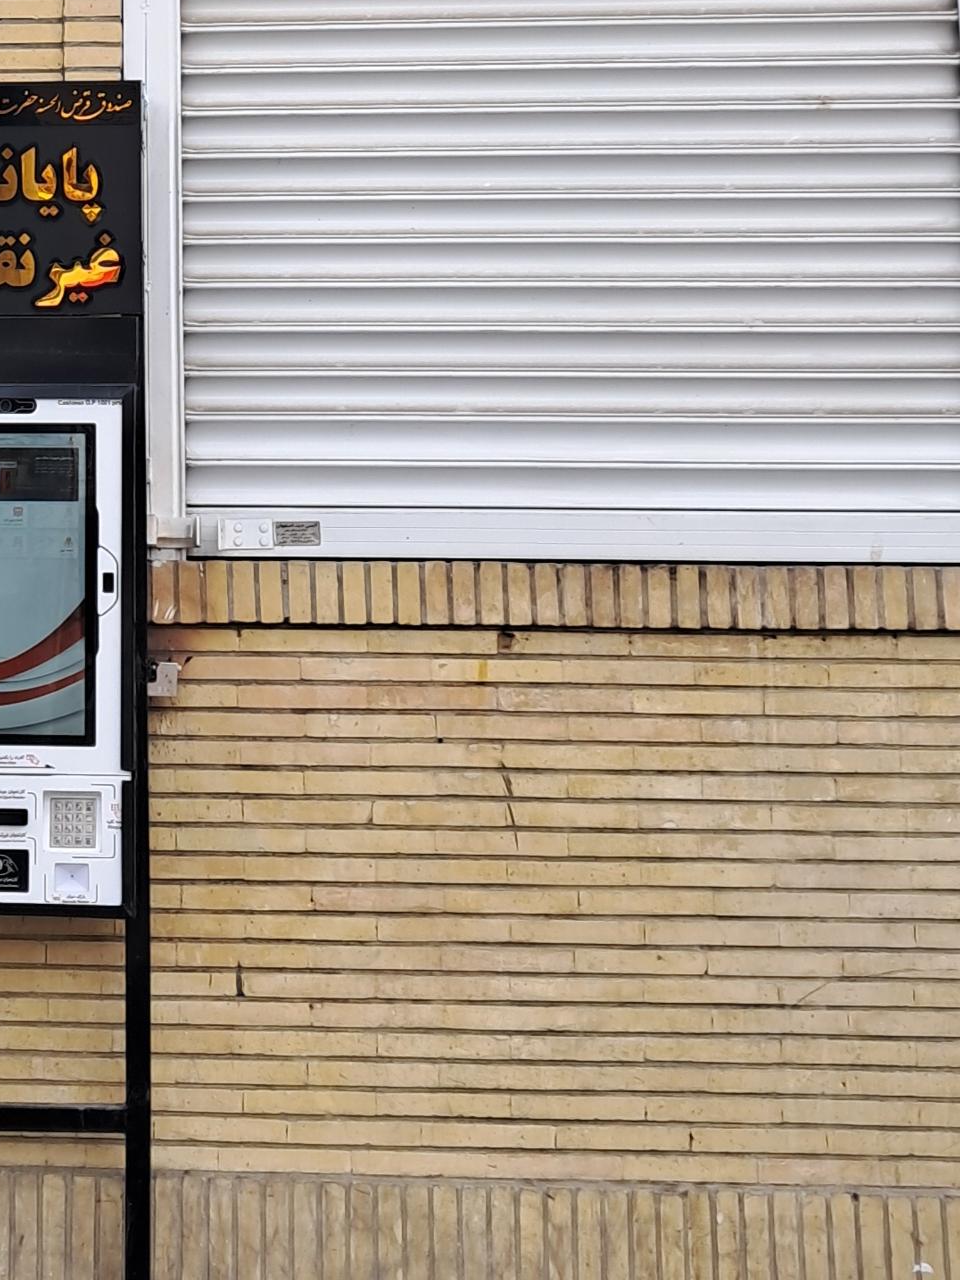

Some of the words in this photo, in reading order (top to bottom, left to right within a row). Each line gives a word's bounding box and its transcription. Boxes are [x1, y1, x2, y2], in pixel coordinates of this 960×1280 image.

[60, 89, 92, 118] قرض
[73, 90, 133, 121] صندوق
[33, 232, 123, 308] غیر
